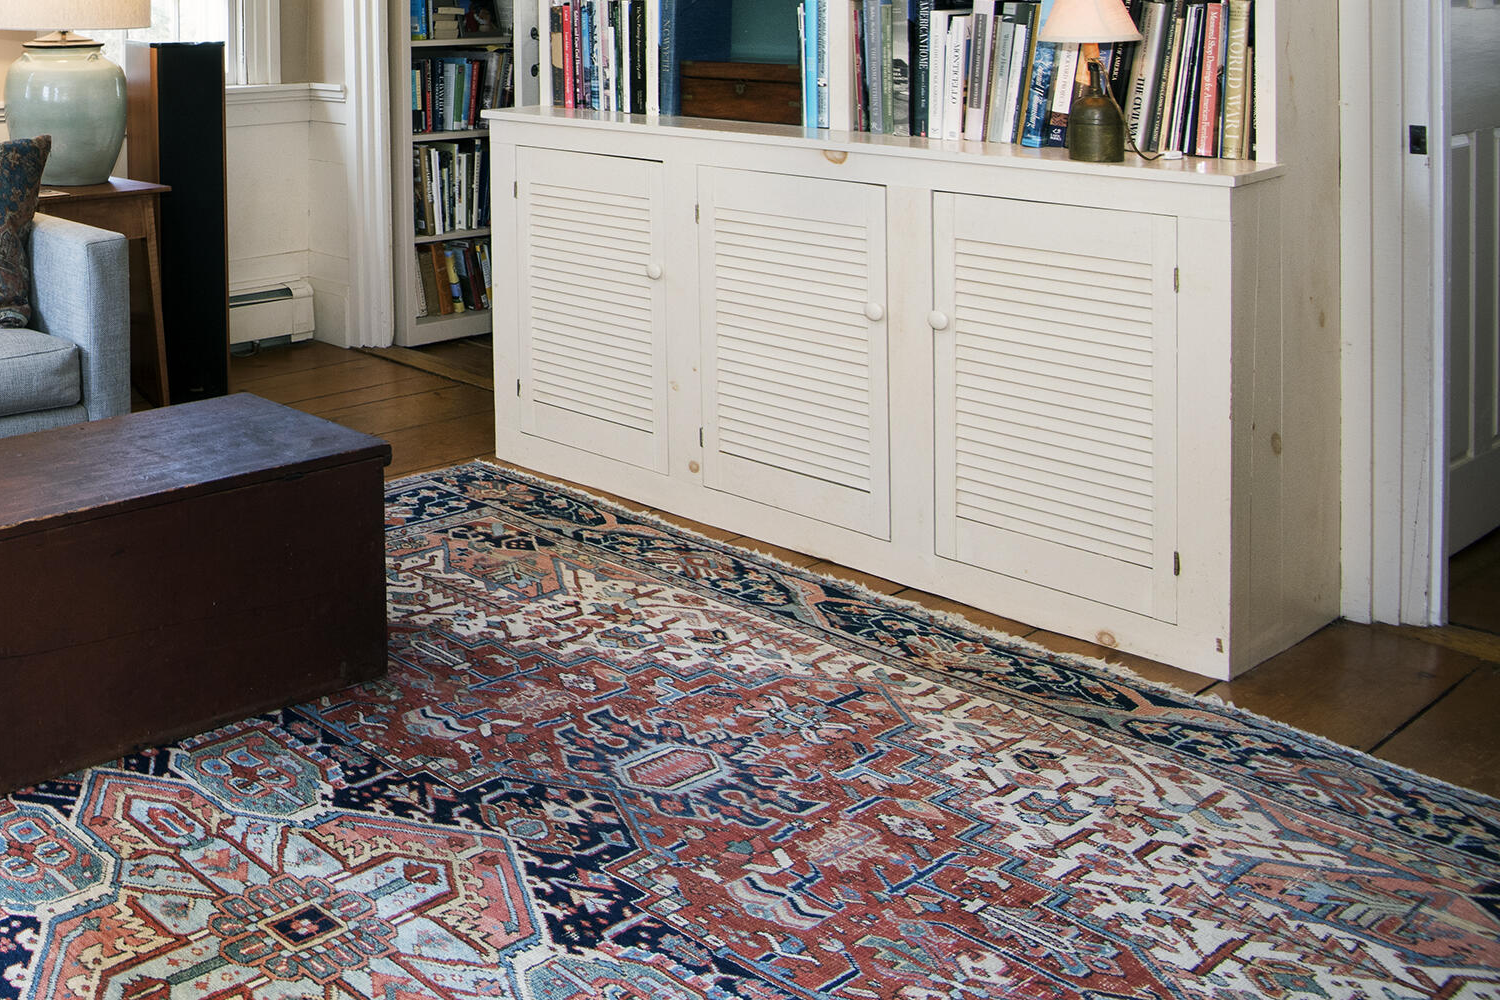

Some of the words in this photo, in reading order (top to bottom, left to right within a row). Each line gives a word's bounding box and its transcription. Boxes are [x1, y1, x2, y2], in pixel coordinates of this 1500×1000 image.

[919, 1, 929, 45] AMERICAN
[1208, 11, 1218, 40] Measured
[918, 45, 928, 70] HOME
[1206, 41, 1216, 55] Shop
[1228, 27, 1245, 88] WORLD
[951, 43, 960, 104] MONTICELLO
[1111, 56, 1121, 81] AMERICA
[1205, 56, 1215, 82] Drawings
[1135, 78, 1145, 95] THE
[1131, 97, 1143, 120] CIVIL
[1202, 93, 1212, 121] American
[1226, 94, 1242, 127] WAR
[1127, 121, 1139, 145] WAR
